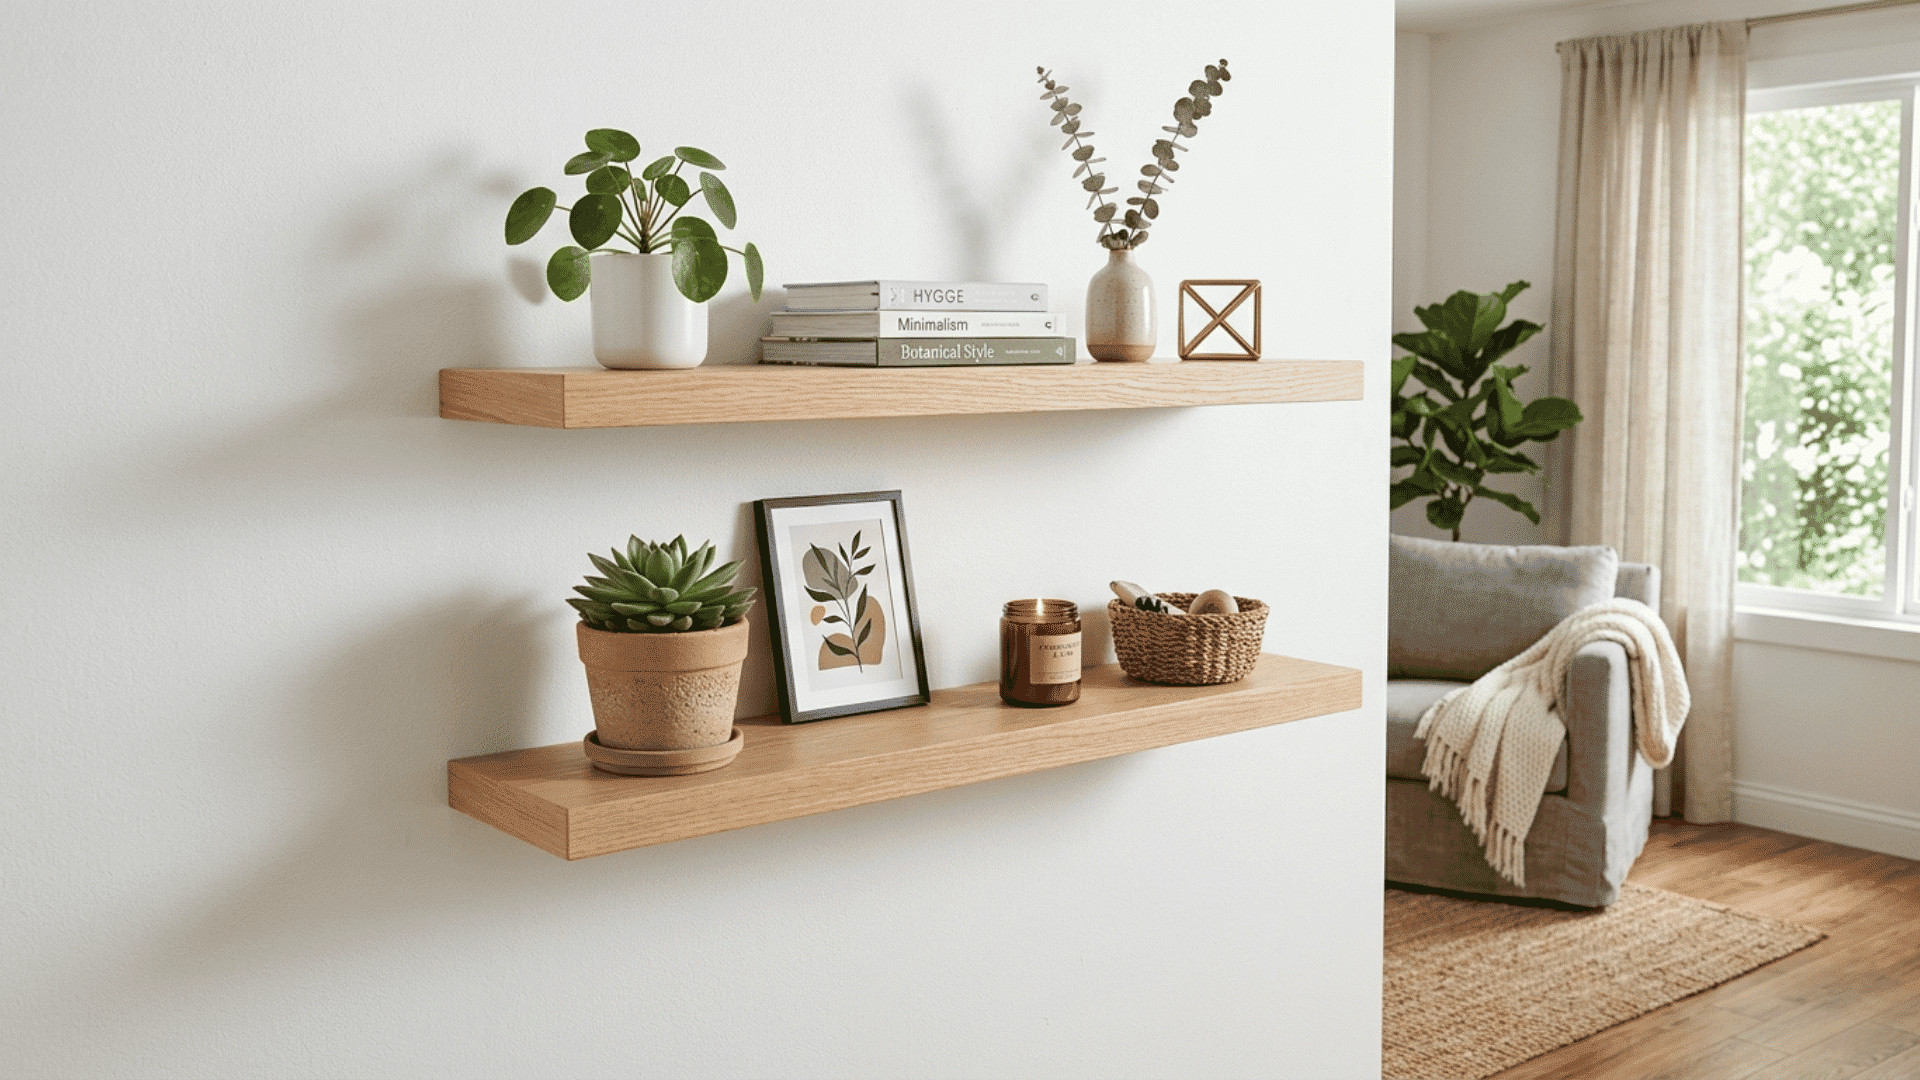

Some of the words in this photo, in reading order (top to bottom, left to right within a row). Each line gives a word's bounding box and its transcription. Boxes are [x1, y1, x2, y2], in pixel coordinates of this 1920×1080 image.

[913, 289, 964, 303] HYGGE
[898, 317, 969, 331] Minimalism
[900, 343, 961, 360] Botanical
[963, 343, 995, 363] Style
